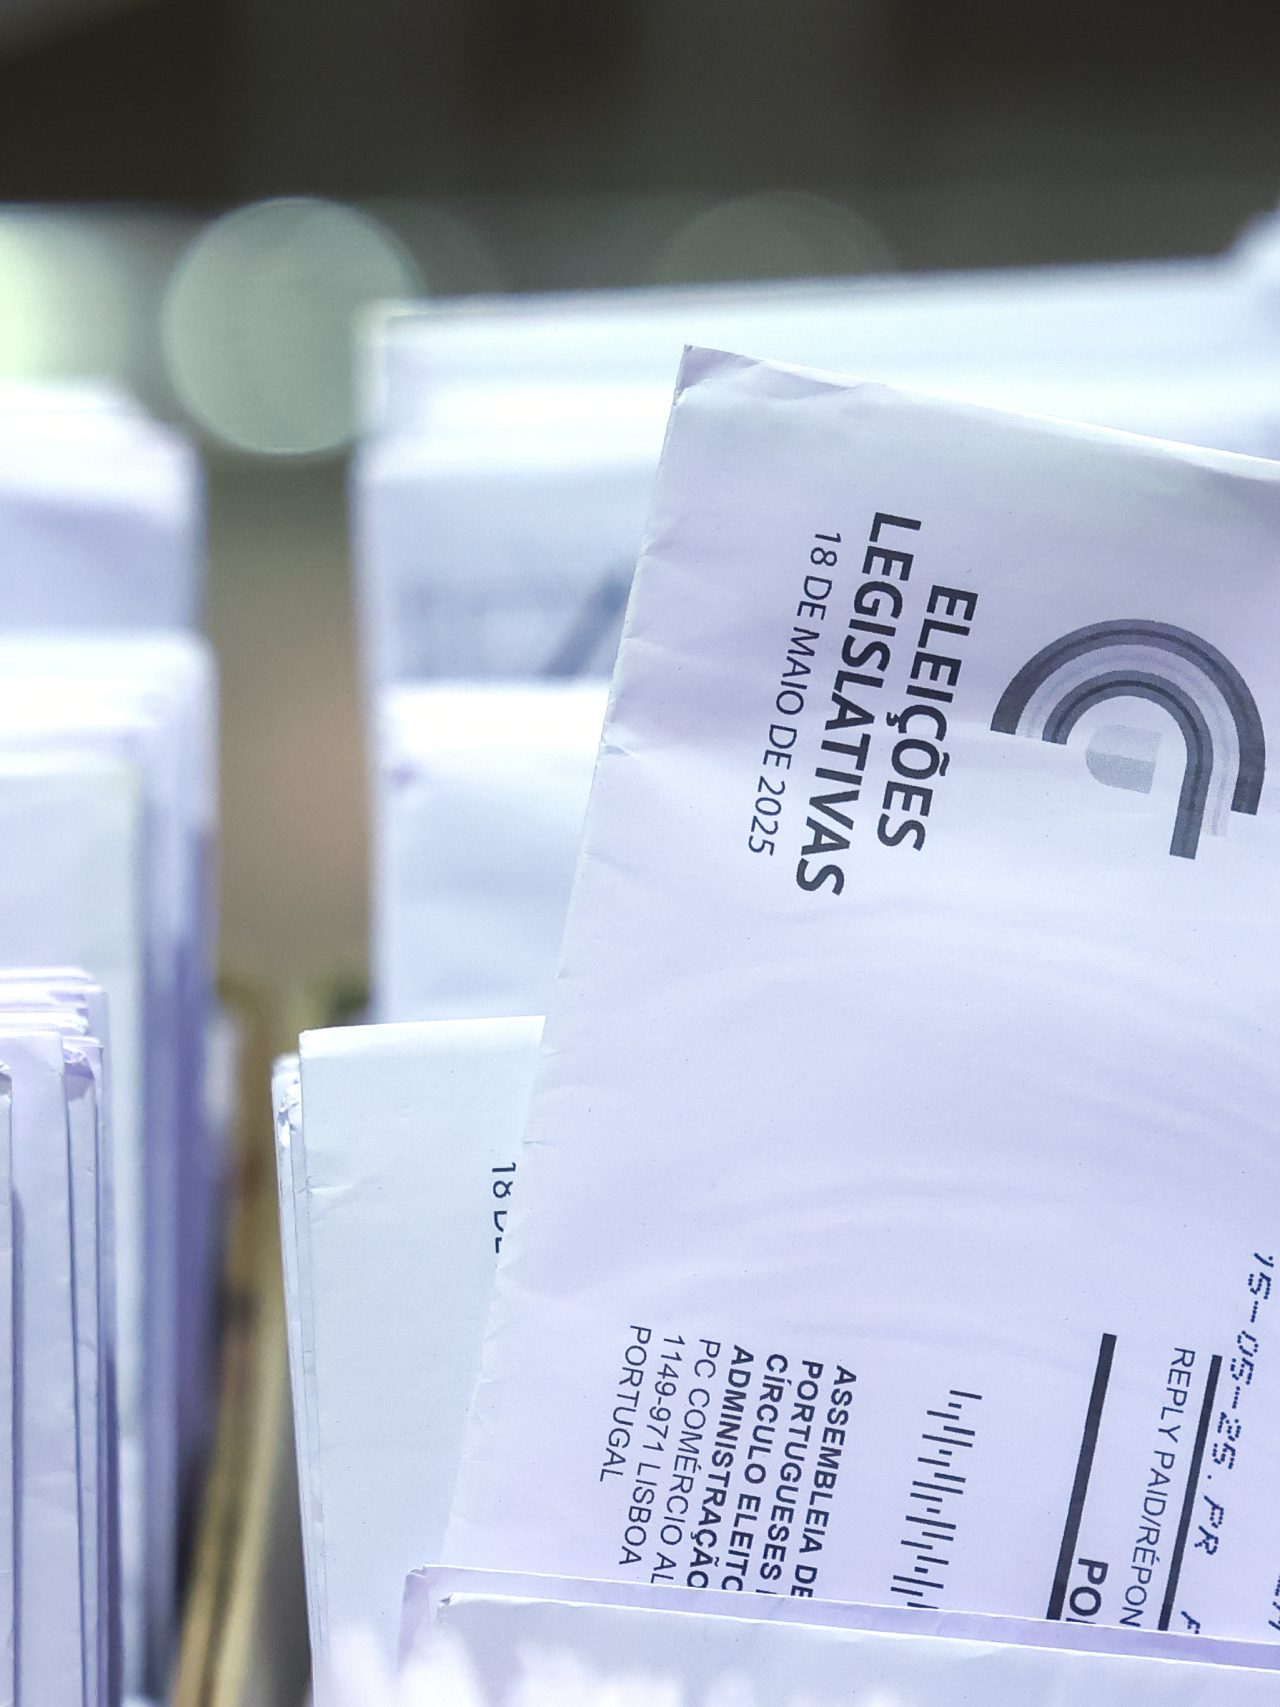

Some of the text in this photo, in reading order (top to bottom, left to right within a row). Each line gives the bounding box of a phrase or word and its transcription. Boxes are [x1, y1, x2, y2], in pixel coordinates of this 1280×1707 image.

[747, 532, 842, 857] 18 DE MAIO DE 2025
[796, 512, 922, 895] LEGISLATIVAS
[877, 585, 978, 851] ELEIÇÕES
[599, 1324, 653, 1483] PORTUGAL
[618, 1335, 686, 1565] 1149-971 LISBOA
[659, 1387, 711, 1546] COMÉRCIO
[687, 1344, 755, 1589] ADMINISTRAÇÃO
[693, 1338, 722, 1379] PC
[743, 1353, 793, 1485] CÍRCULO
[798, 1364, 857, 1554] ASSEMBLEIA
[759, 1359, 825, 1581] PORTUGUESES
[1118, 1347, 1196, 1628] REPLY PAID/RÉPON
[1065, 1557, 1109, 1625] PO
